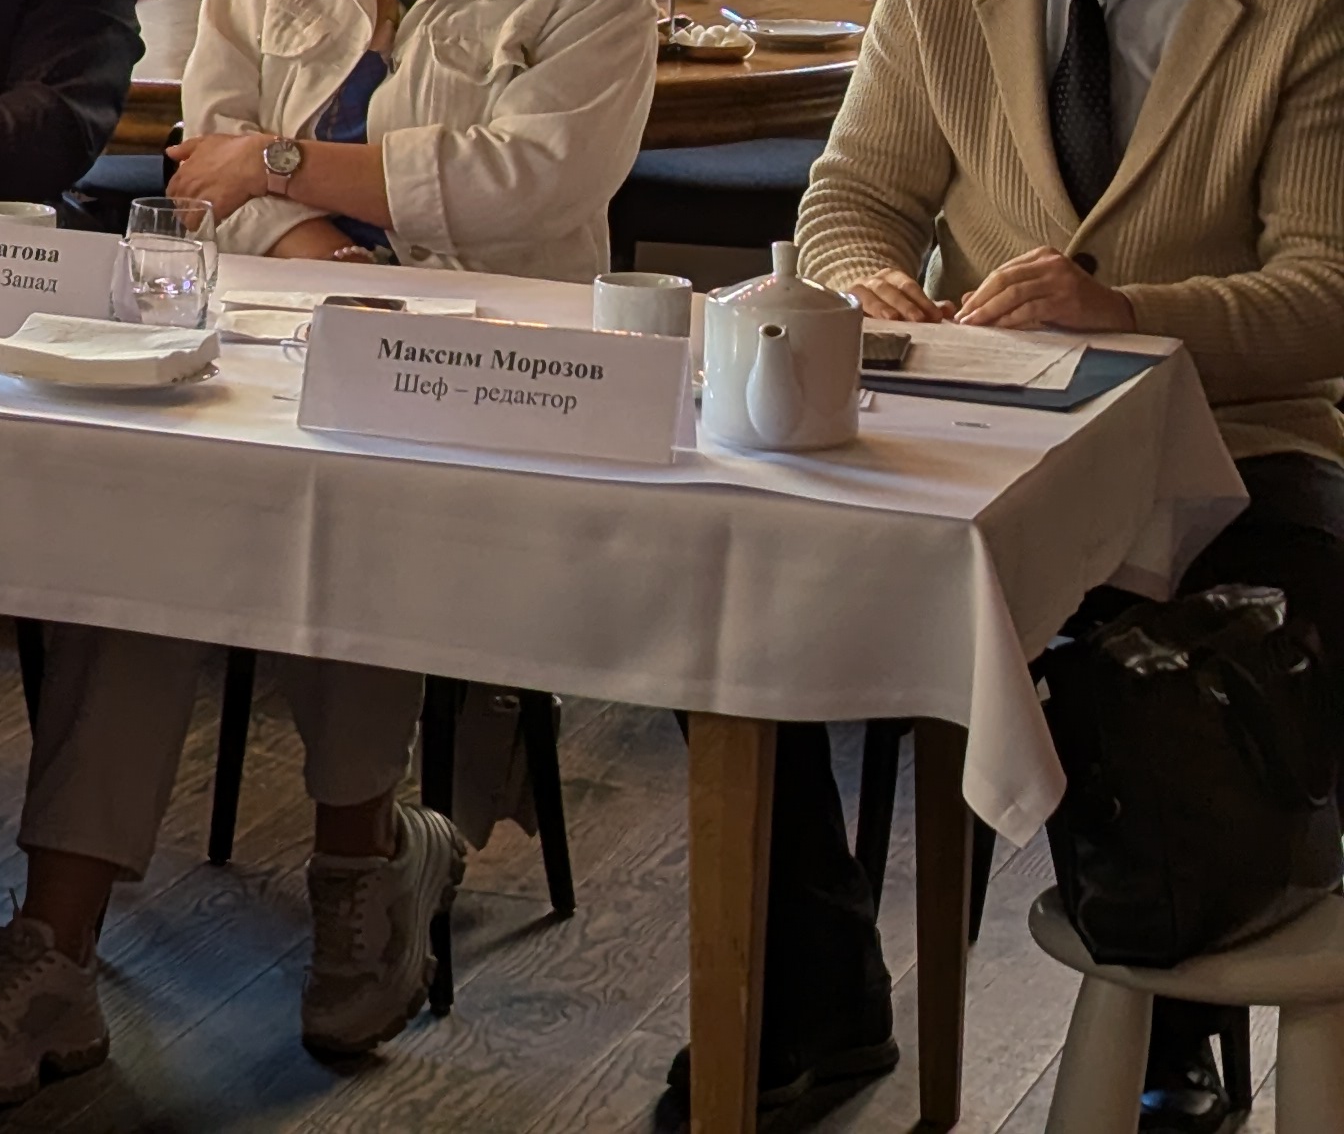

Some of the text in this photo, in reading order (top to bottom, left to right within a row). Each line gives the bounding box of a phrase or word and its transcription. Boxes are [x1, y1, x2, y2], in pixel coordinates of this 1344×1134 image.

[376, 337, 605, 381] Максим Морозов
[393, 371, 450, 401] Шеф
[473, 385, 578, 415] редактор
